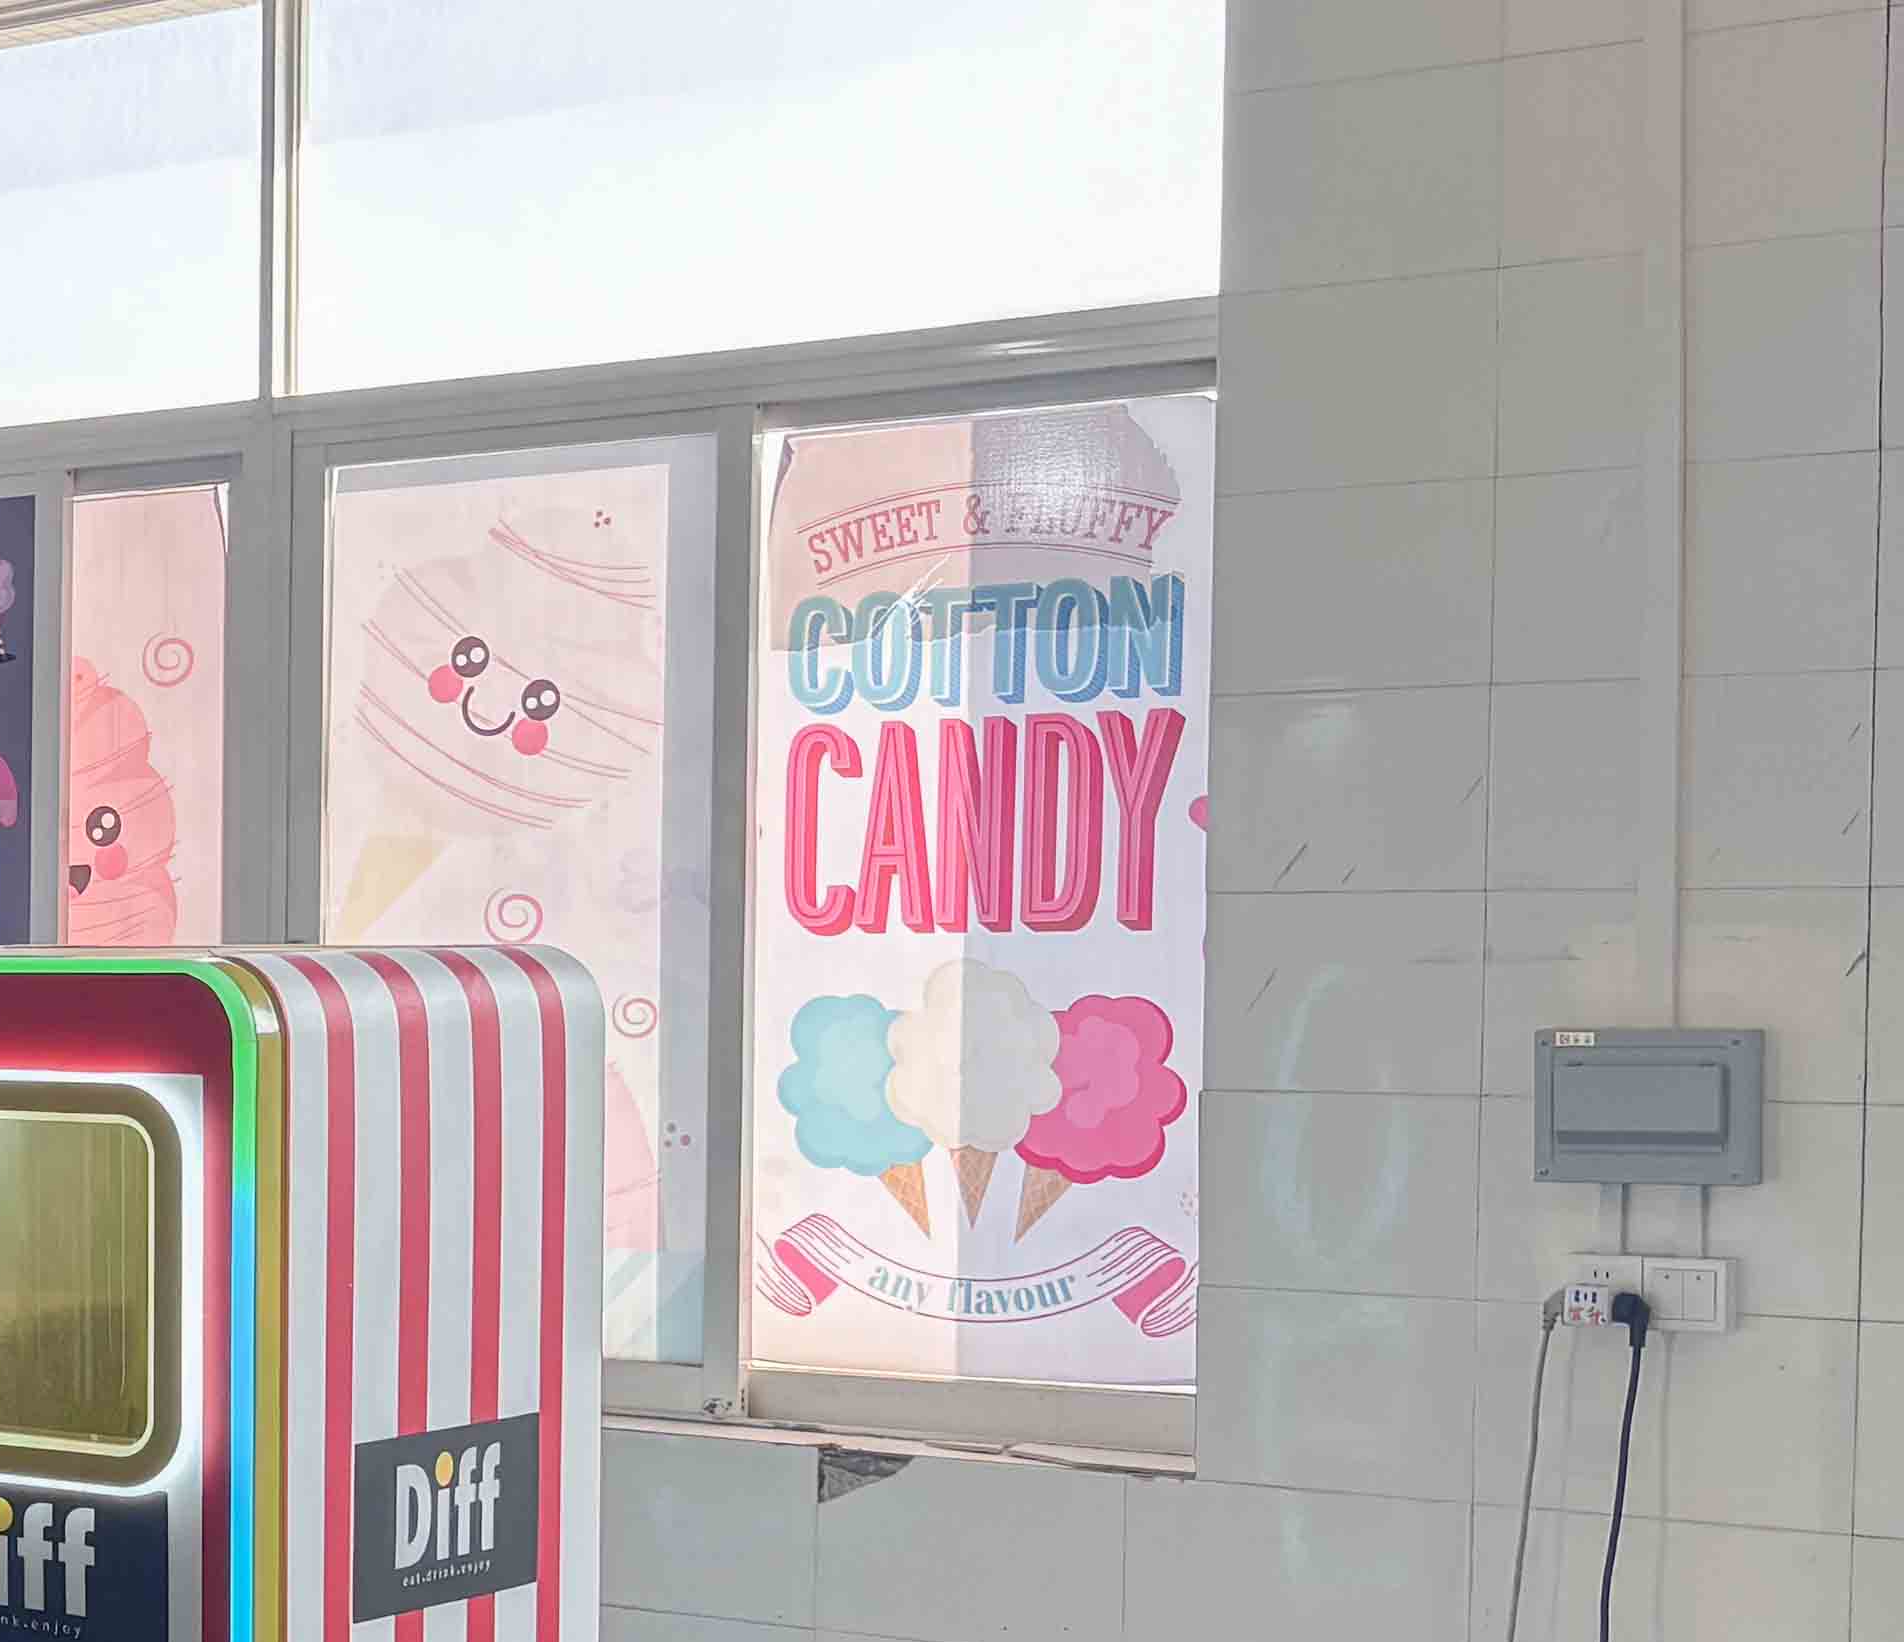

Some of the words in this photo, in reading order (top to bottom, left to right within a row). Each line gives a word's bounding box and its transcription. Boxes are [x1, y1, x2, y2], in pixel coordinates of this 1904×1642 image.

[807, 499, 942, 573] SWEET
[963, 495, 990, 535] &
[1005, 495, 1174, 552] FLUFFY
[787, 573, 1186, 716] COTTON
[784, 708, 1187, 937] CANDY
[867, 1264, 930, 1311] any
[947, 1274, 1076, 1314] flavour
[395, 1441, 502, 1570] Diff
